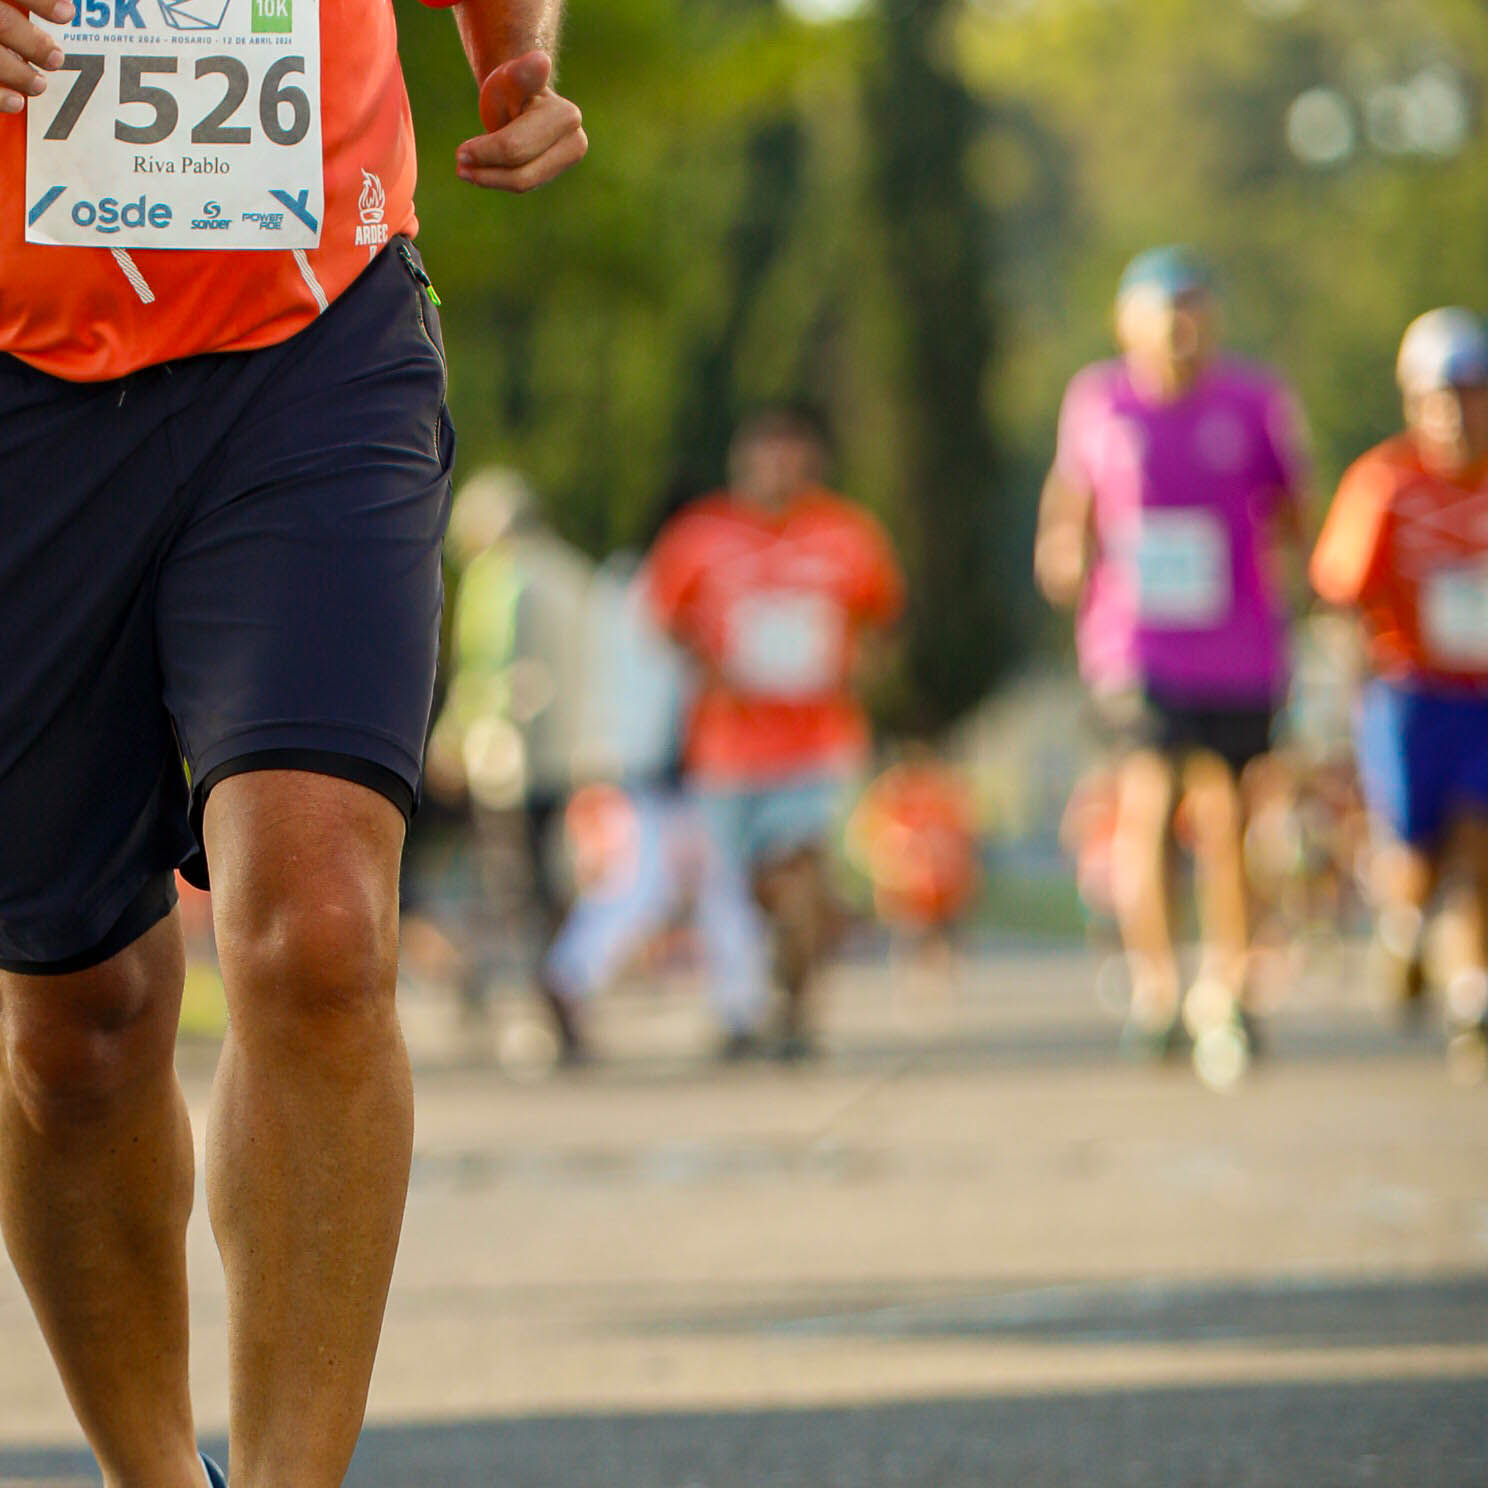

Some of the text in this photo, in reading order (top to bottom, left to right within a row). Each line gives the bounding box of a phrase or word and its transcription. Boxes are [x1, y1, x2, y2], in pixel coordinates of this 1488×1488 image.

[63, 32, 100, 41] PUERTO
[103, 33, 134, 43] NORTE
[171, 35, 212, 45] ROSARIO
[223, 36, 232, 45] 12
[235, 36, 246, 45] DE
[249, 36, 273, 45] ABRIL
[43, 54, 311, 146] 7526
[133, 155, 230, 174] Riva Pablo
[71, 194, 173, 231] osde
[241, 212, 284, 223] POWER
